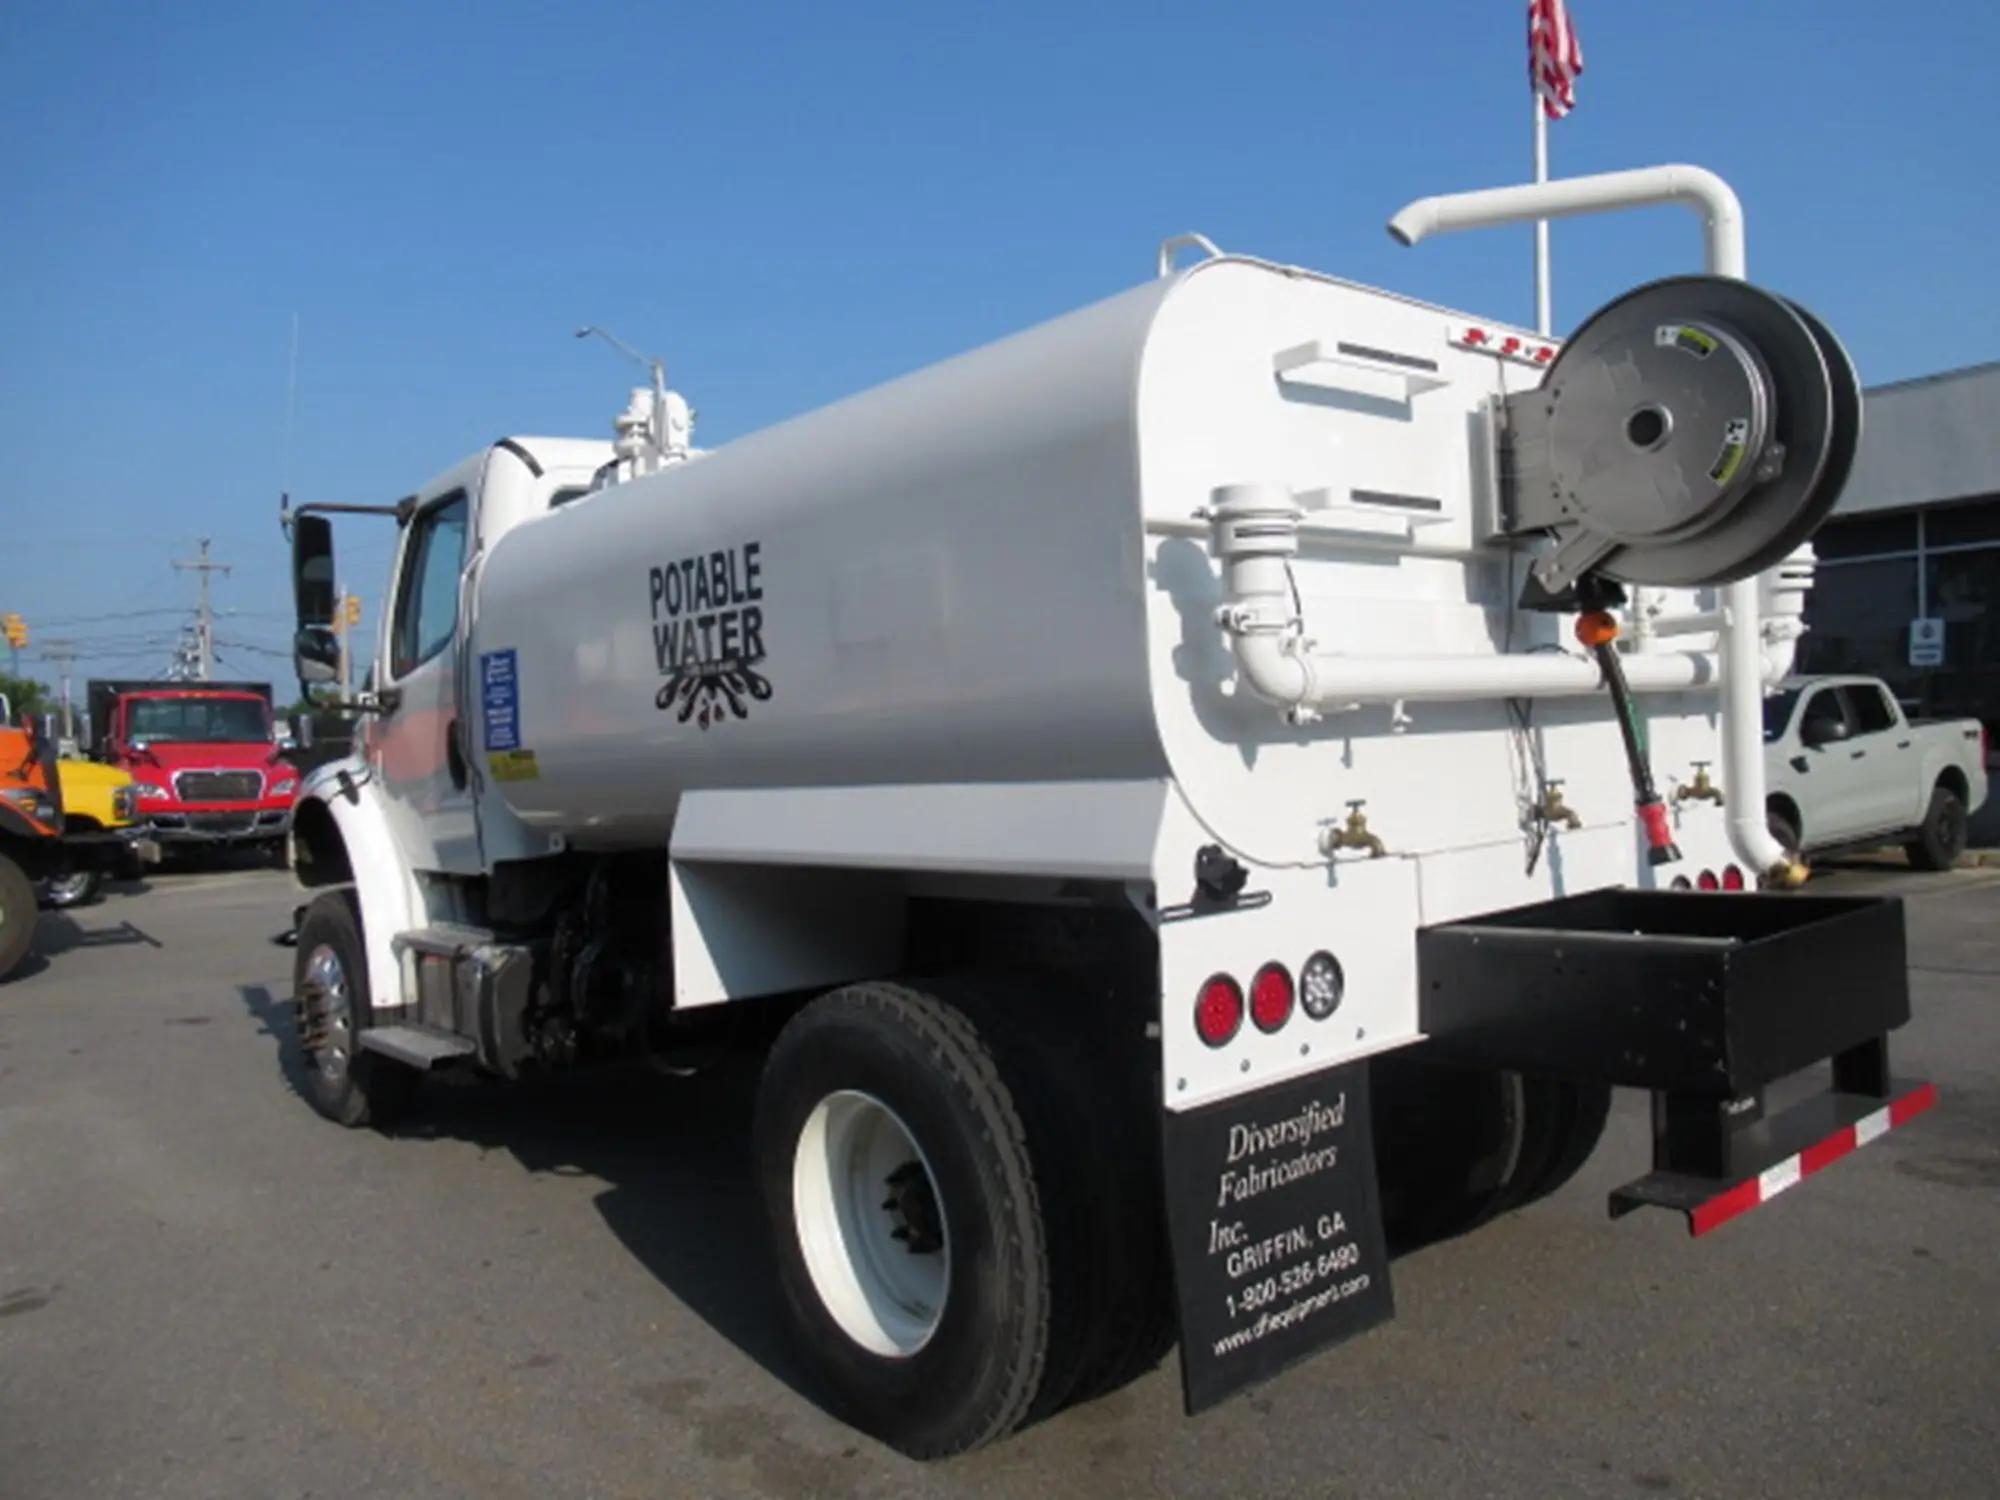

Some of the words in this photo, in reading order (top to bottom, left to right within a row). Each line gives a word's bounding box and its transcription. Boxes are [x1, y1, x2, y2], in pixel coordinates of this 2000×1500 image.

[649, 541, 763, 620] POTABLE
[653, 605, 766, 675] WATER
[1227, 1091, 1346, 1163] Diversified
[1217, 1146, 1338, 1208] Fabricators
[1208, 1219, 1248, 1256] Inc.
[1317, 1211, 1346, 1240] GA
